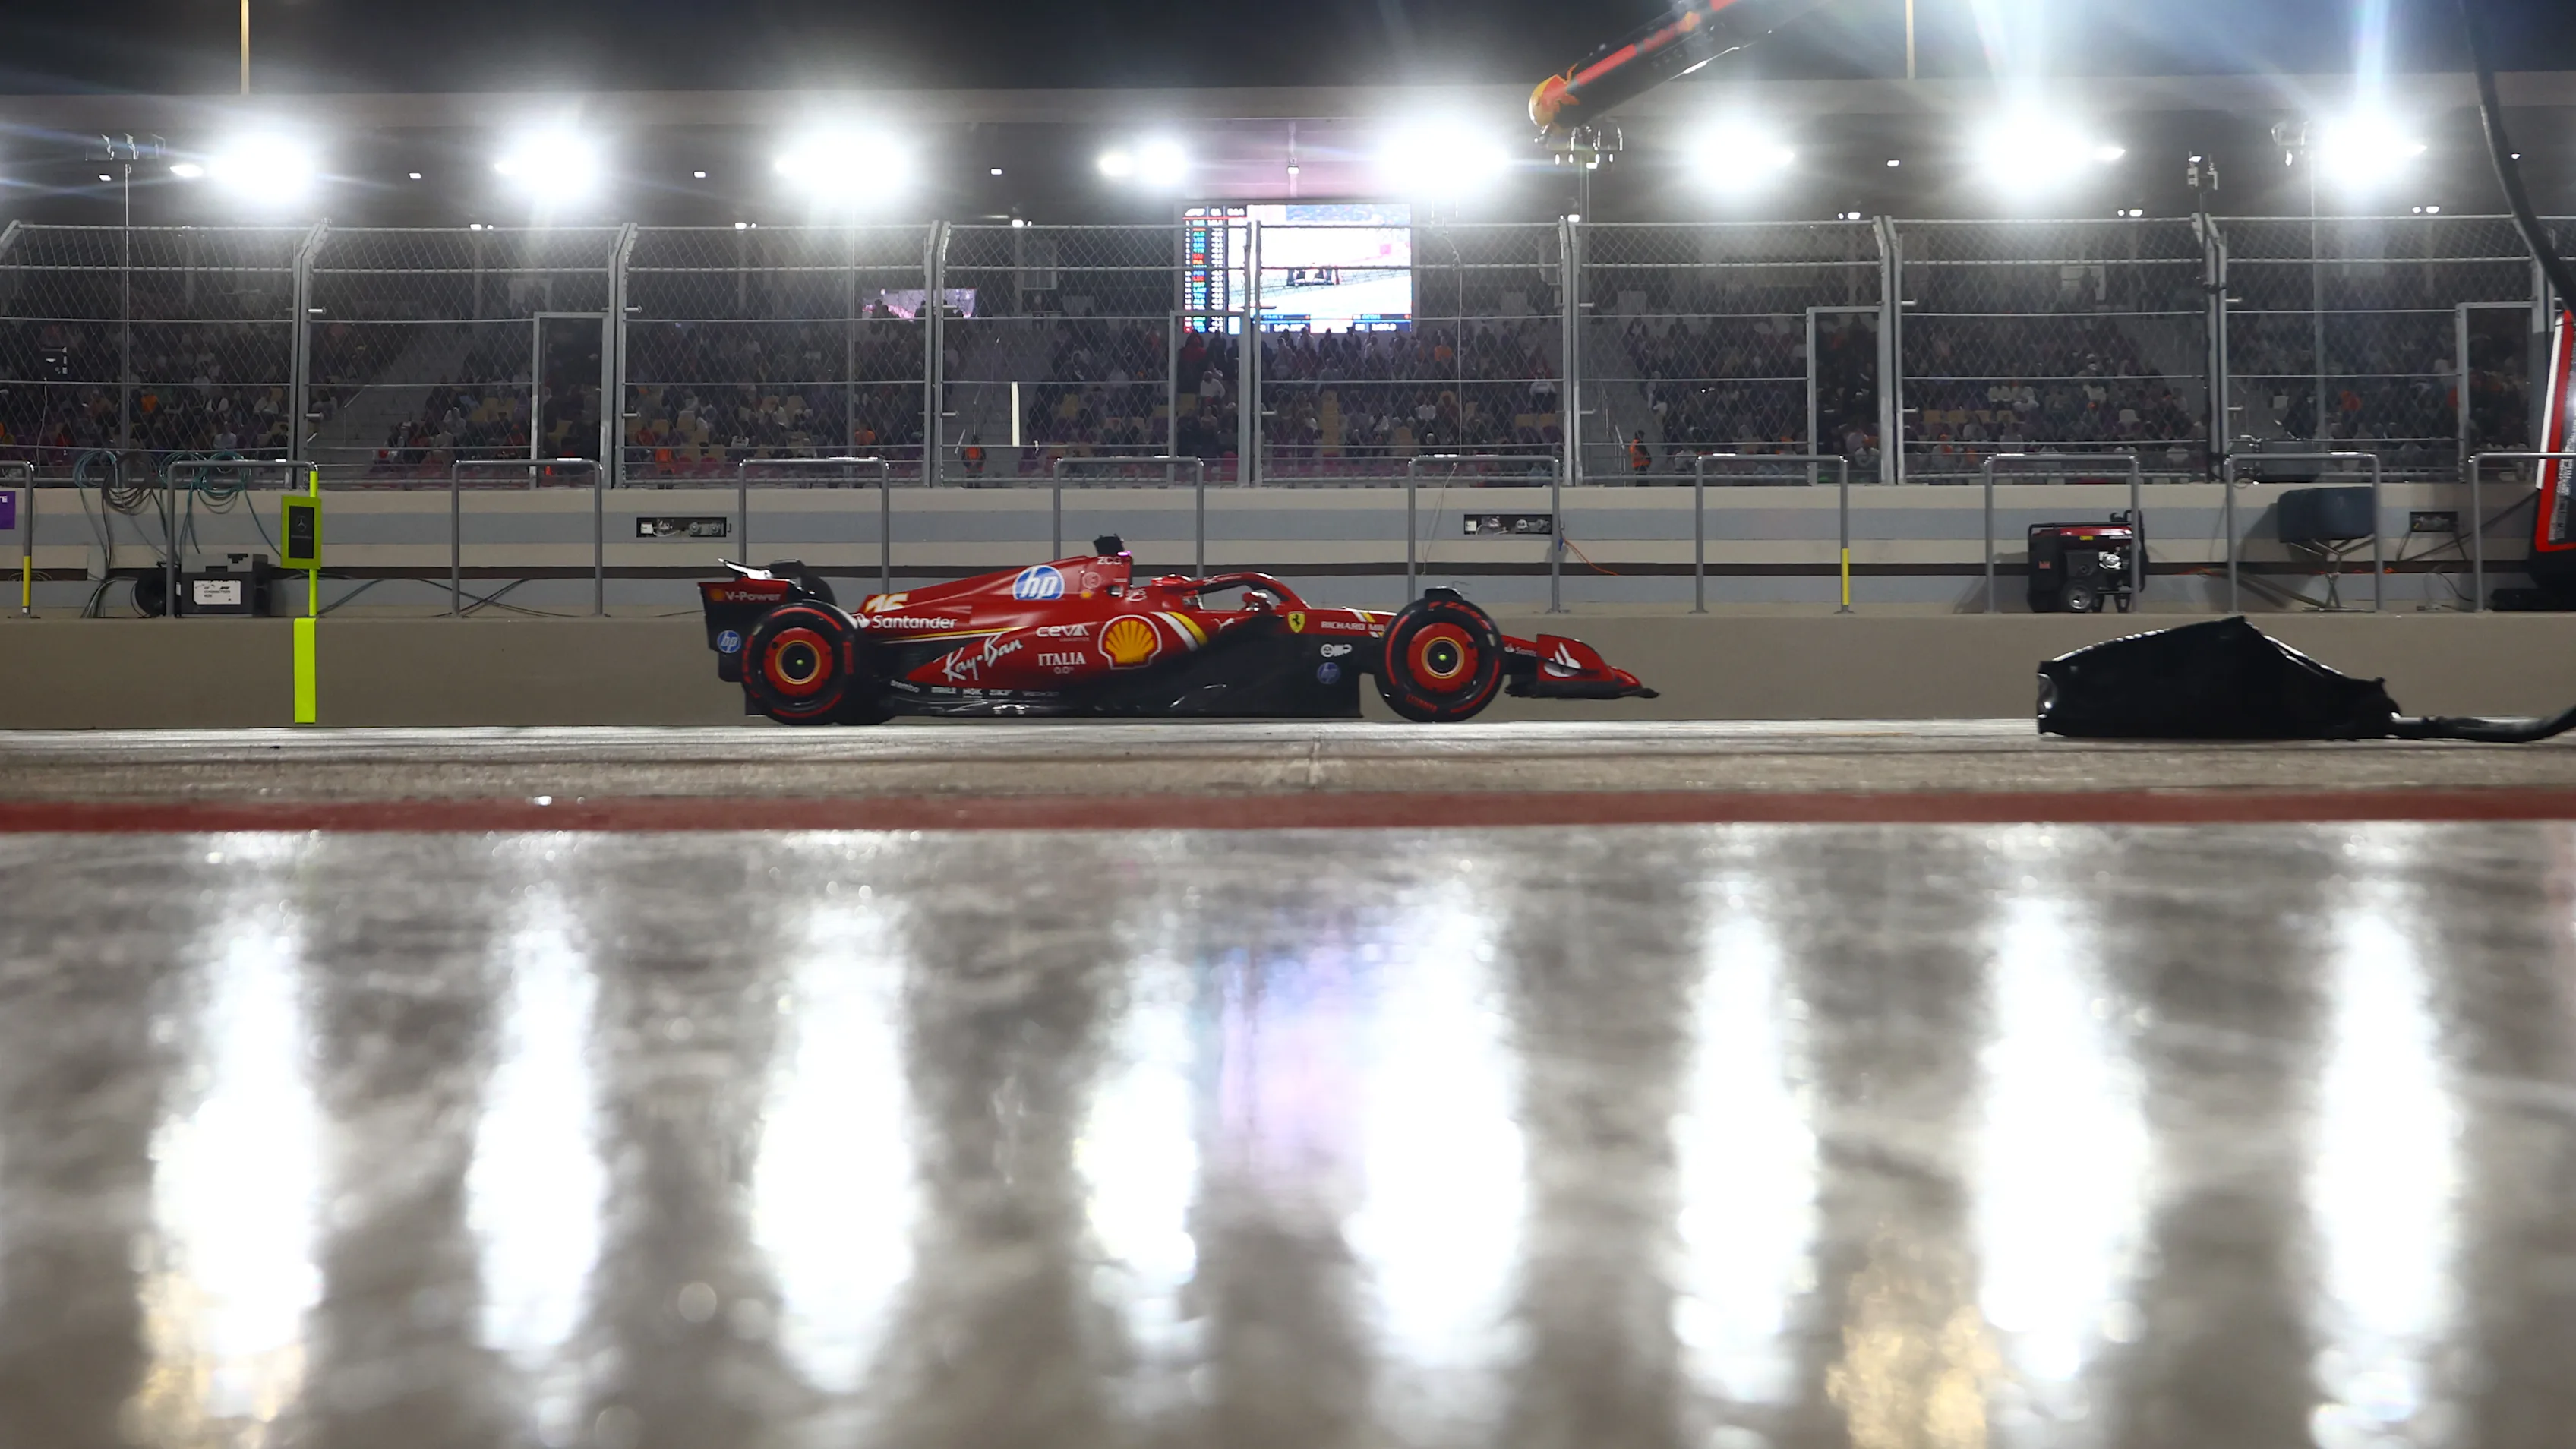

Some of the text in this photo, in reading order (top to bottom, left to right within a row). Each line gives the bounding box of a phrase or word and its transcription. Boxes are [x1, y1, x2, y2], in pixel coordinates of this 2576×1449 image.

[1020, 566, 1059, 599] hp
[725, 591, 781, 601] V-Power
[872, 615, 958, 629] Santander
[1321, 621, 1385, 632] RICHARD MIL
[720, 630, 738, 652] hp
[942, 632, 1024, 682] Ray-Ban
[1037, 652, 1087, 666] ITALIA
